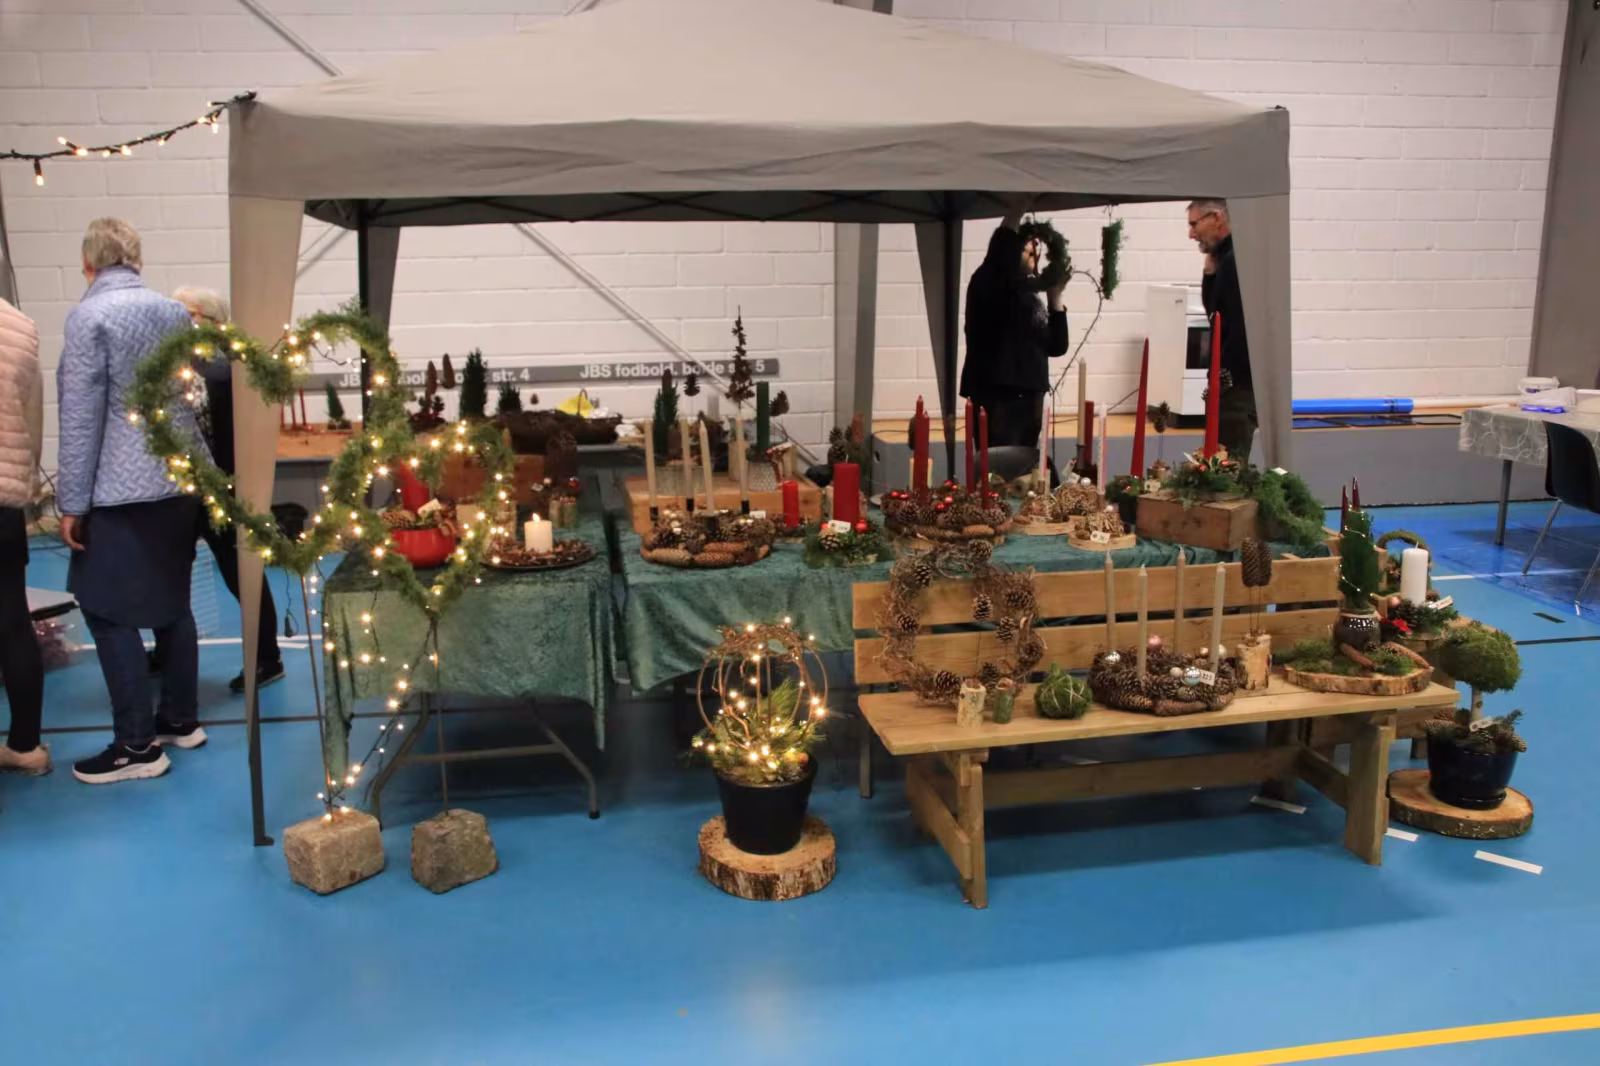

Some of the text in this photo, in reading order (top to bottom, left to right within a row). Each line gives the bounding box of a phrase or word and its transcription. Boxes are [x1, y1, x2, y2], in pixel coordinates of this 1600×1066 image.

[340, 373, 363, 388] JB
[492, 368, 516, 382] str.
[520, 368, 530, 381] 4
[580, 364, 611, 378] JBS
[755, 360, 765, 372] 5
